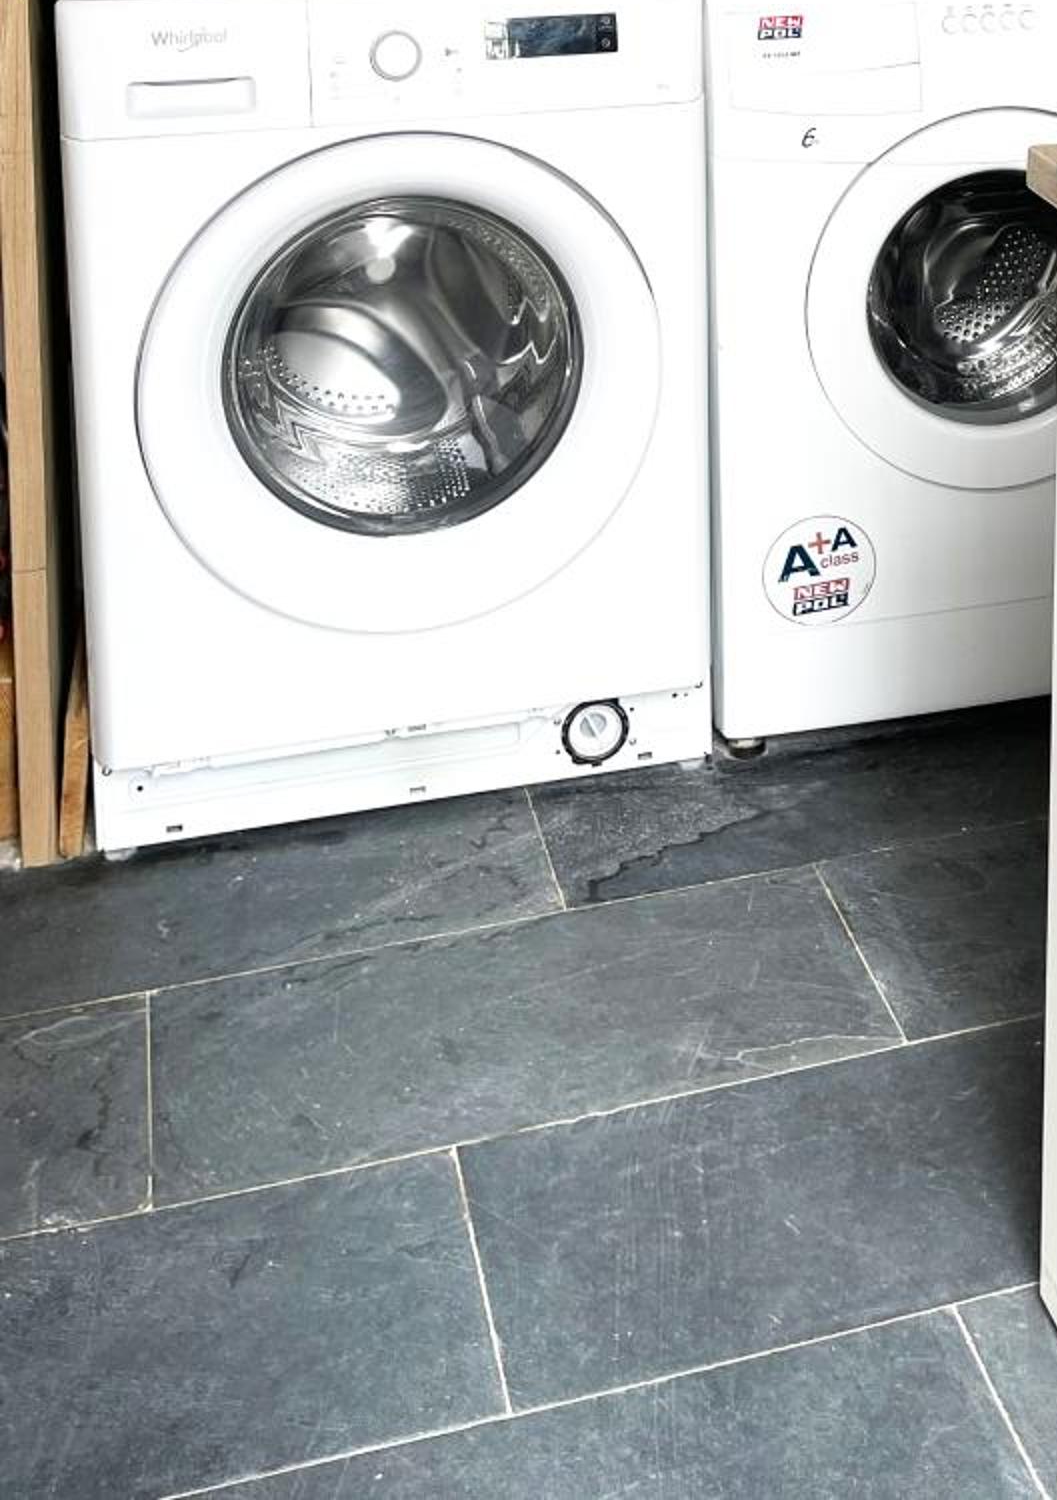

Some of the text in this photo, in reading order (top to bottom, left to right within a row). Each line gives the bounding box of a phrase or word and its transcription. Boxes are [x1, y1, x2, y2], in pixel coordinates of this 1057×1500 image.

[760, 16, 802, 28] NEW
[151, 27, 228, 51] Whirlpool
[759, 28, 800, 40] POL
[819, 552, 860, 569] class
[795, 578, 849, 600] NEW
[793, 594, 849, 616] POL
